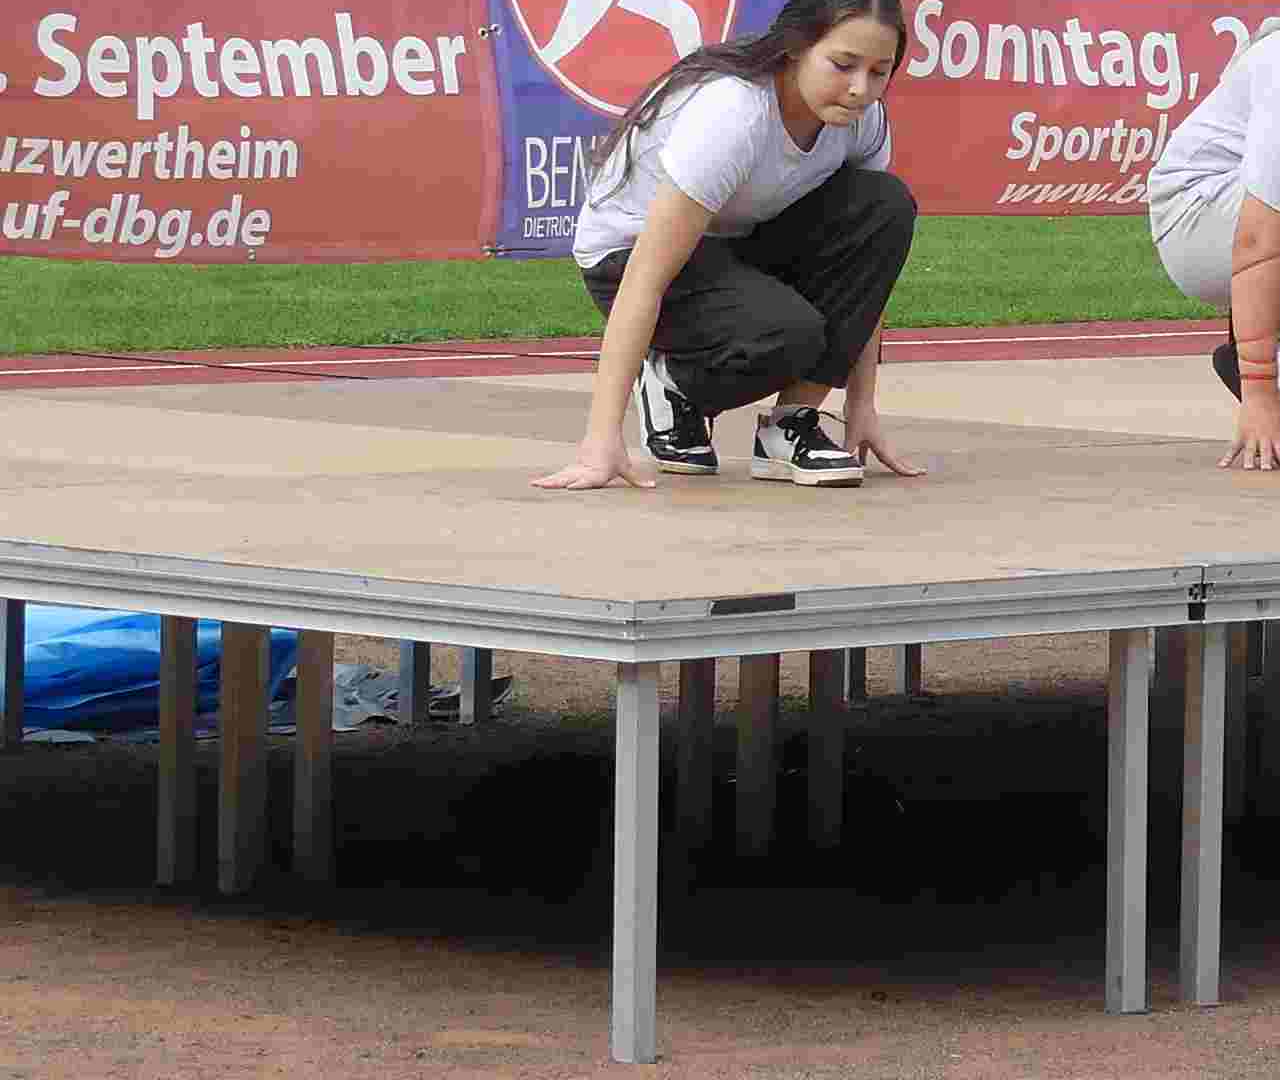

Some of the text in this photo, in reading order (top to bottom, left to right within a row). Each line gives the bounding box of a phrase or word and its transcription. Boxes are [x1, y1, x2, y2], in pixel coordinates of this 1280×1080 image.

[33, 12, 466, 121] September
[906, 0, 1200, 110] Sonntag,
[1006, 110, 1168, 173] Sportpl
